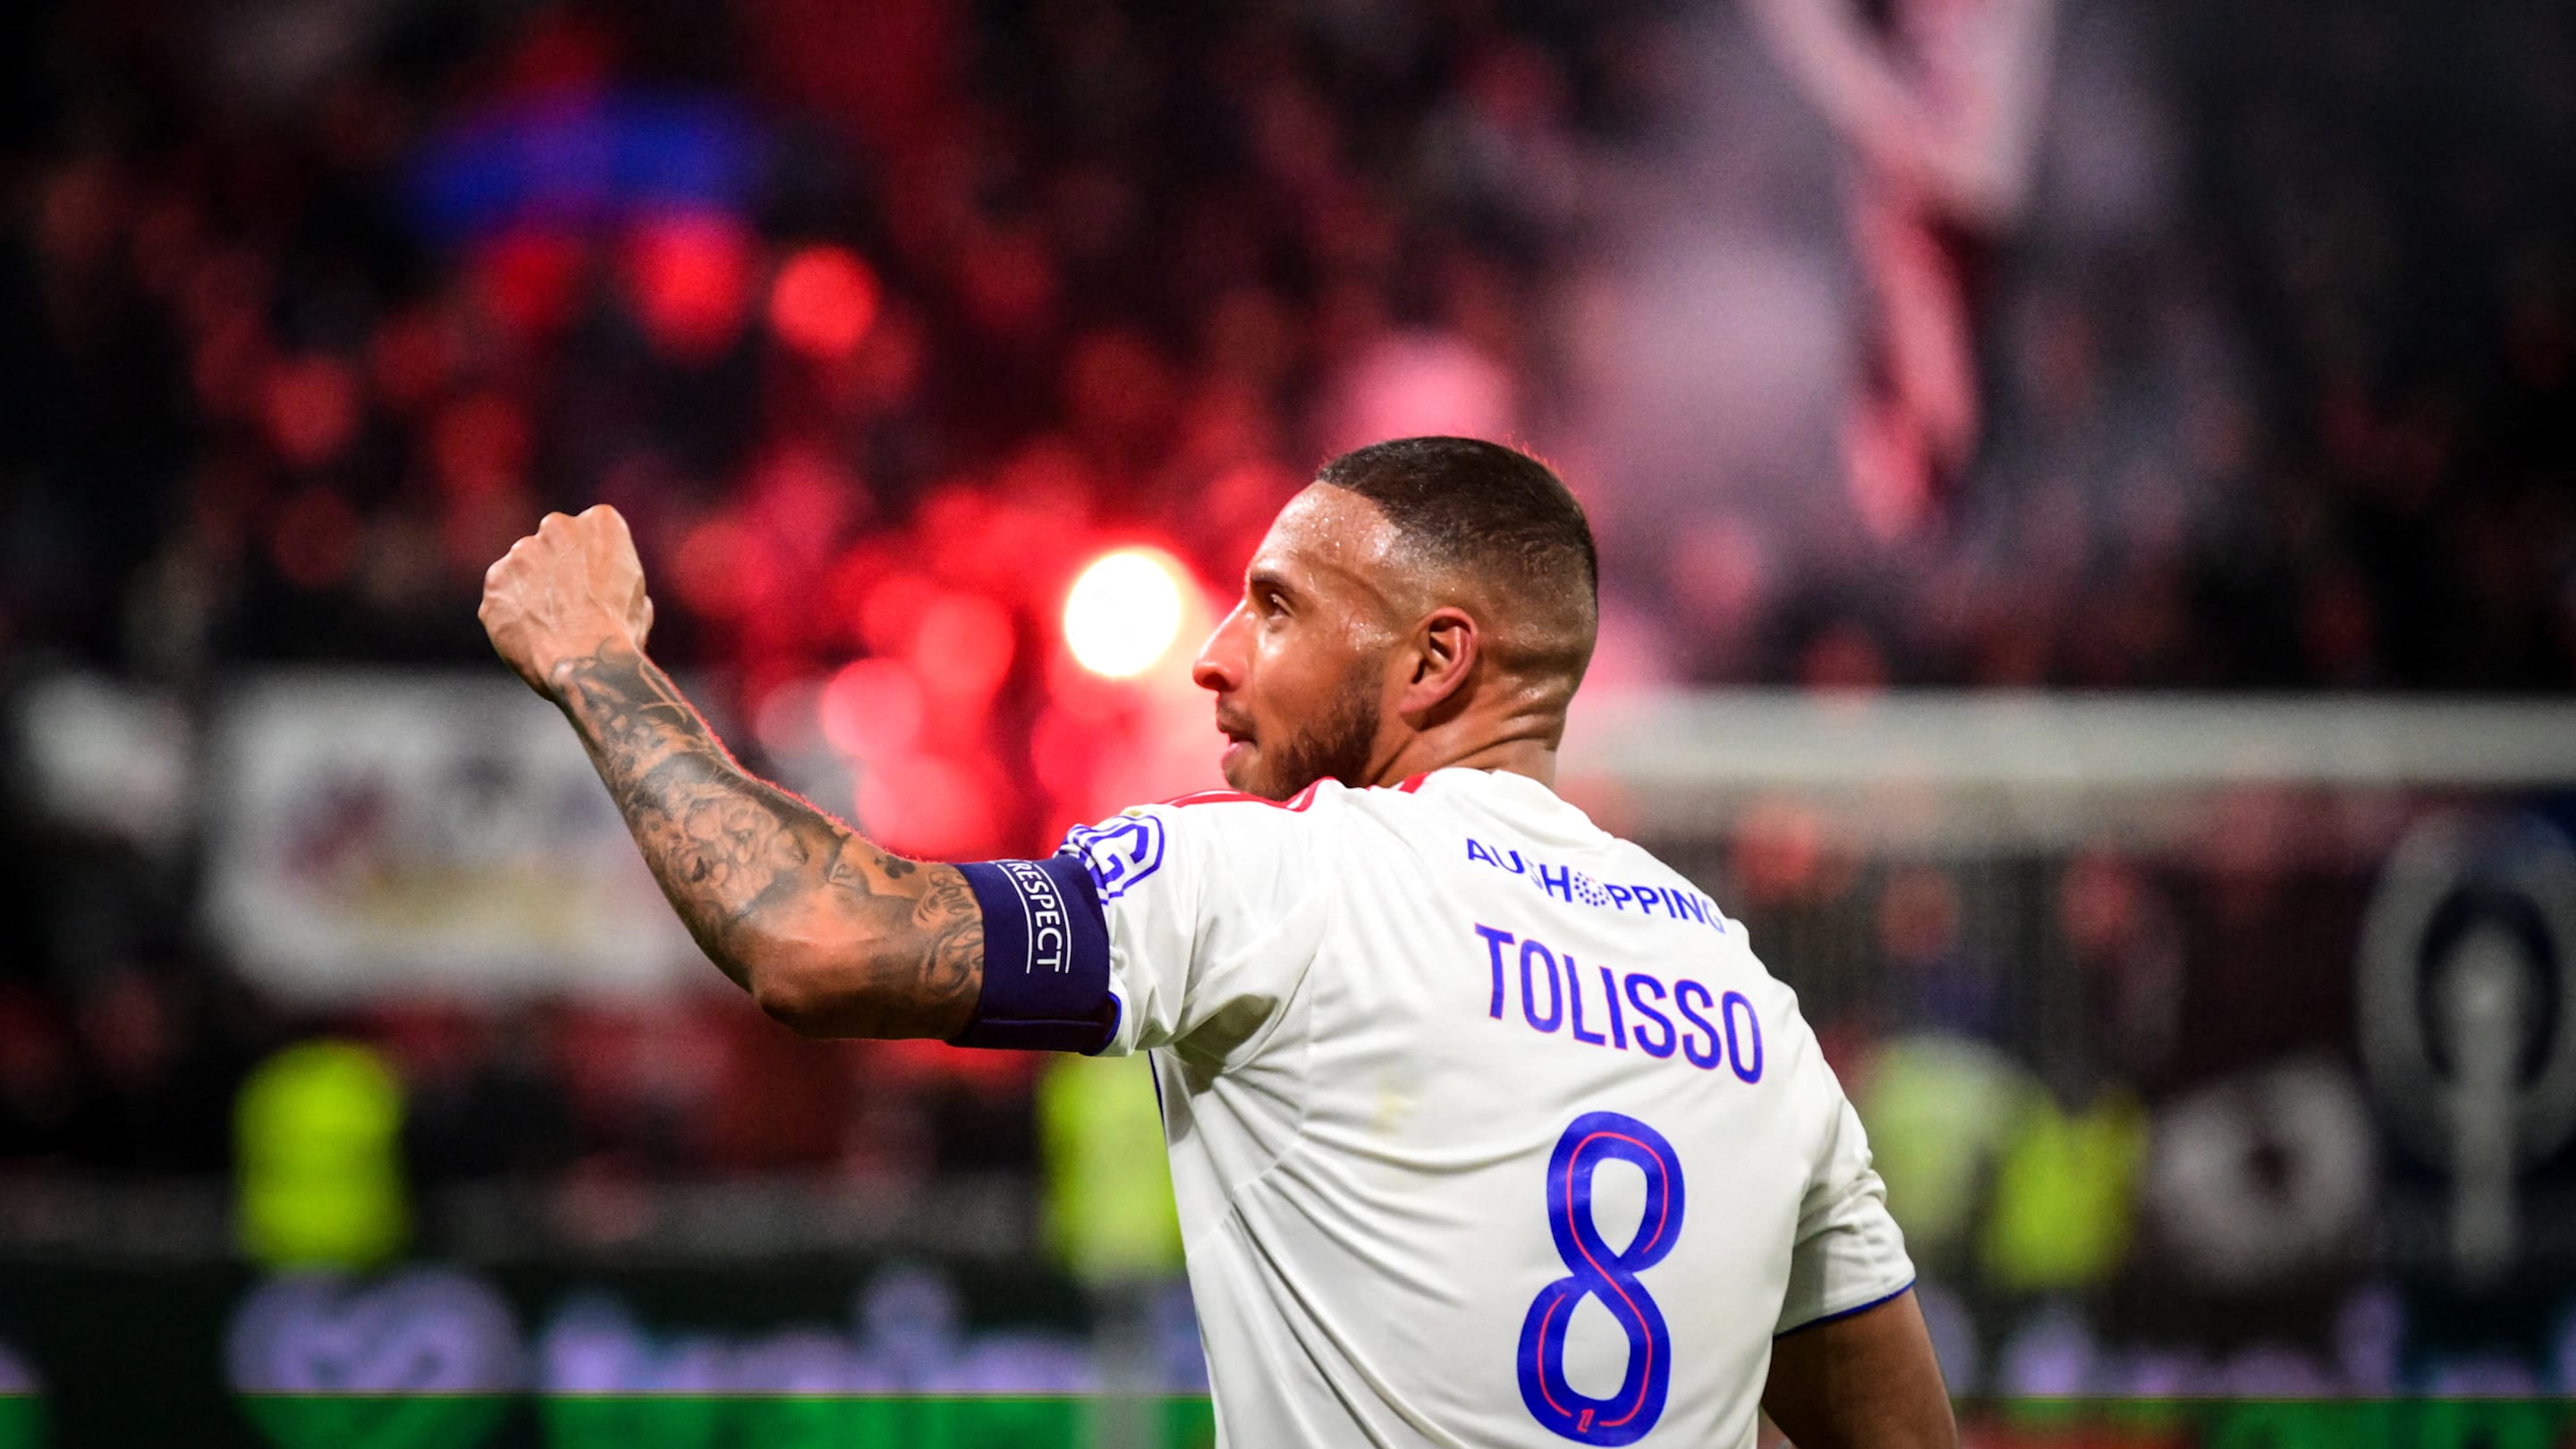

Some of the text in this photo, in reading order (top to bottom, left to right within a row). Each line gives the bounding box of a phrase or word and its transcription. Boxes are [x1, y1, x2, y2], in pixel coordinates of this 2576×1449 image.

[1006, 862, 1062, 973] RESPECT
[1474, 922, 1764, 1085] TOLISSO
[1516, 1110, 1686, 1447] 8
